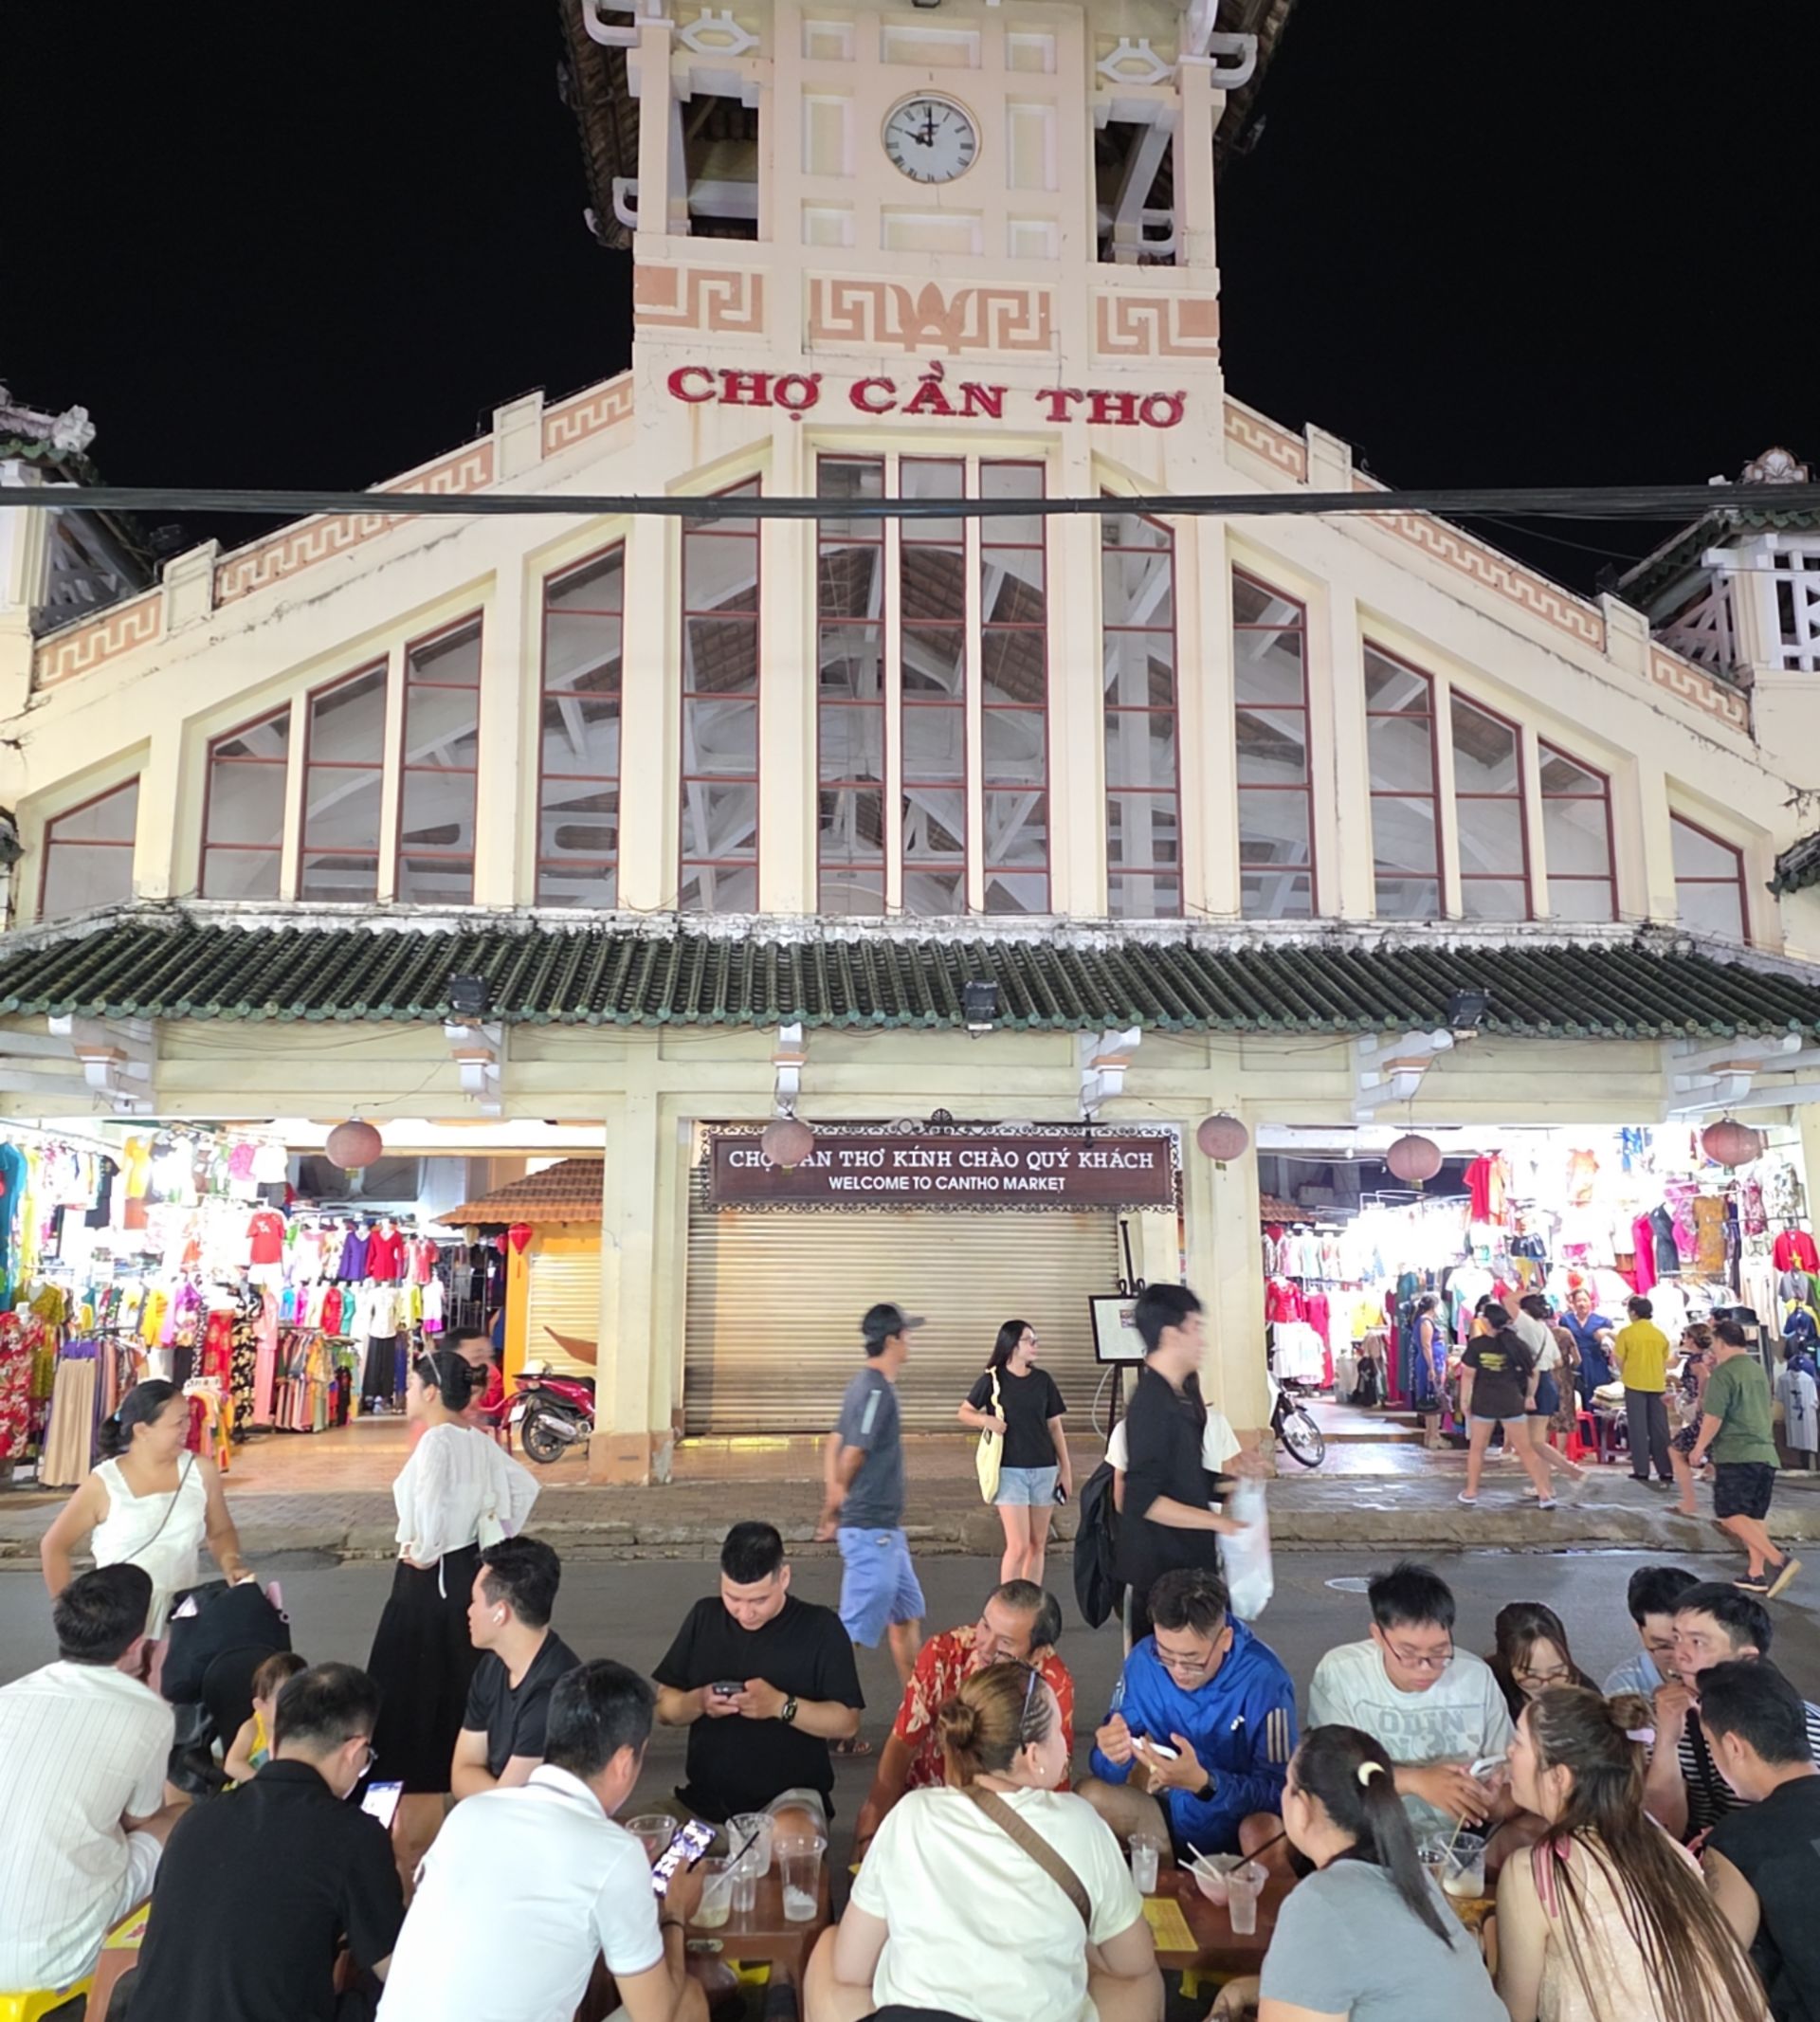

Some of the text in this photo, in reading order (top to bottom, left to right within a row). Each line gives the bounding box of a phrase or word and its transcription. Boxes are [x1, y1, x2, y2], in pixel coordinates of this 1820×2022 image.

[667, 360, 1187, 428] CHỢ CẦN THƠ
[839, 1148, 885, 1167] THƠ
[893, 1145, 952, 1167] KÍNH
[958, 1146, 1020, 1168] CHÀO
[1027, 1147, 1071, 1171] QUÝ
[1078, 1148, 1154, 1169] KHÁCH
[828, 1175, 1065, 1191] WELCOME TO CANTHO MARKET
